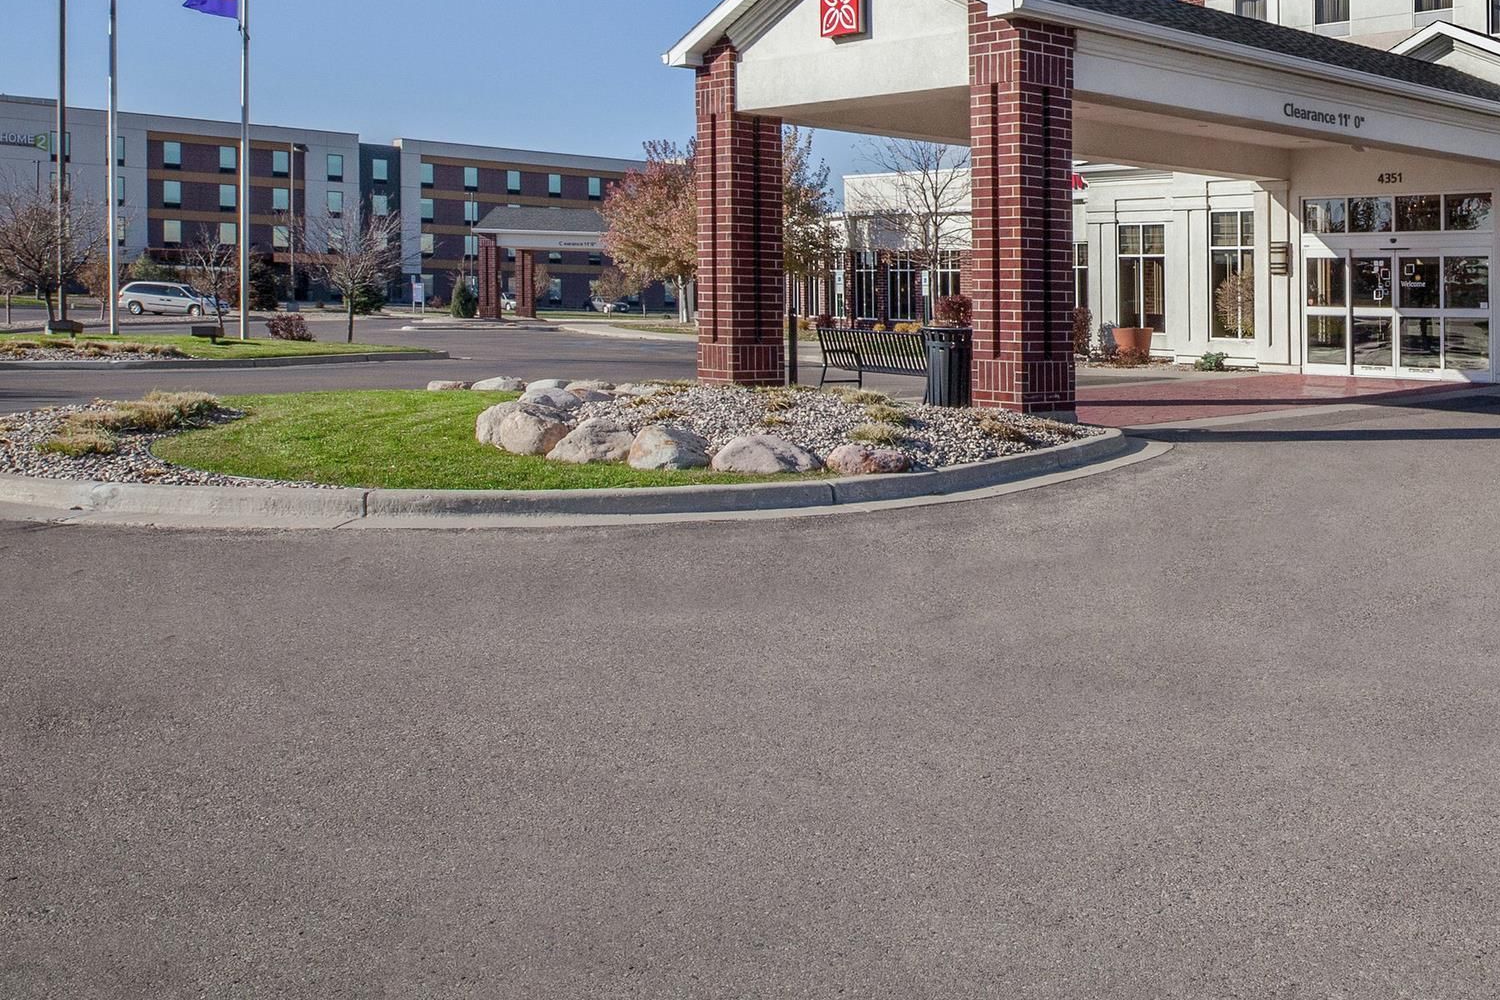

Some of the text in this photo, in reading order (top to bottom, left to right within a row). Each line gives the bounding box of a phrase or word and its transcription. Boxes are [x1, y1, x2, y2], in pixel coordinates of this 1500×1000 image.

[1283, 102, 1336, 125] Clearance
[1377, 172, 1403, 184] 4351
[1401, 280, 1426, 288] Welcome
